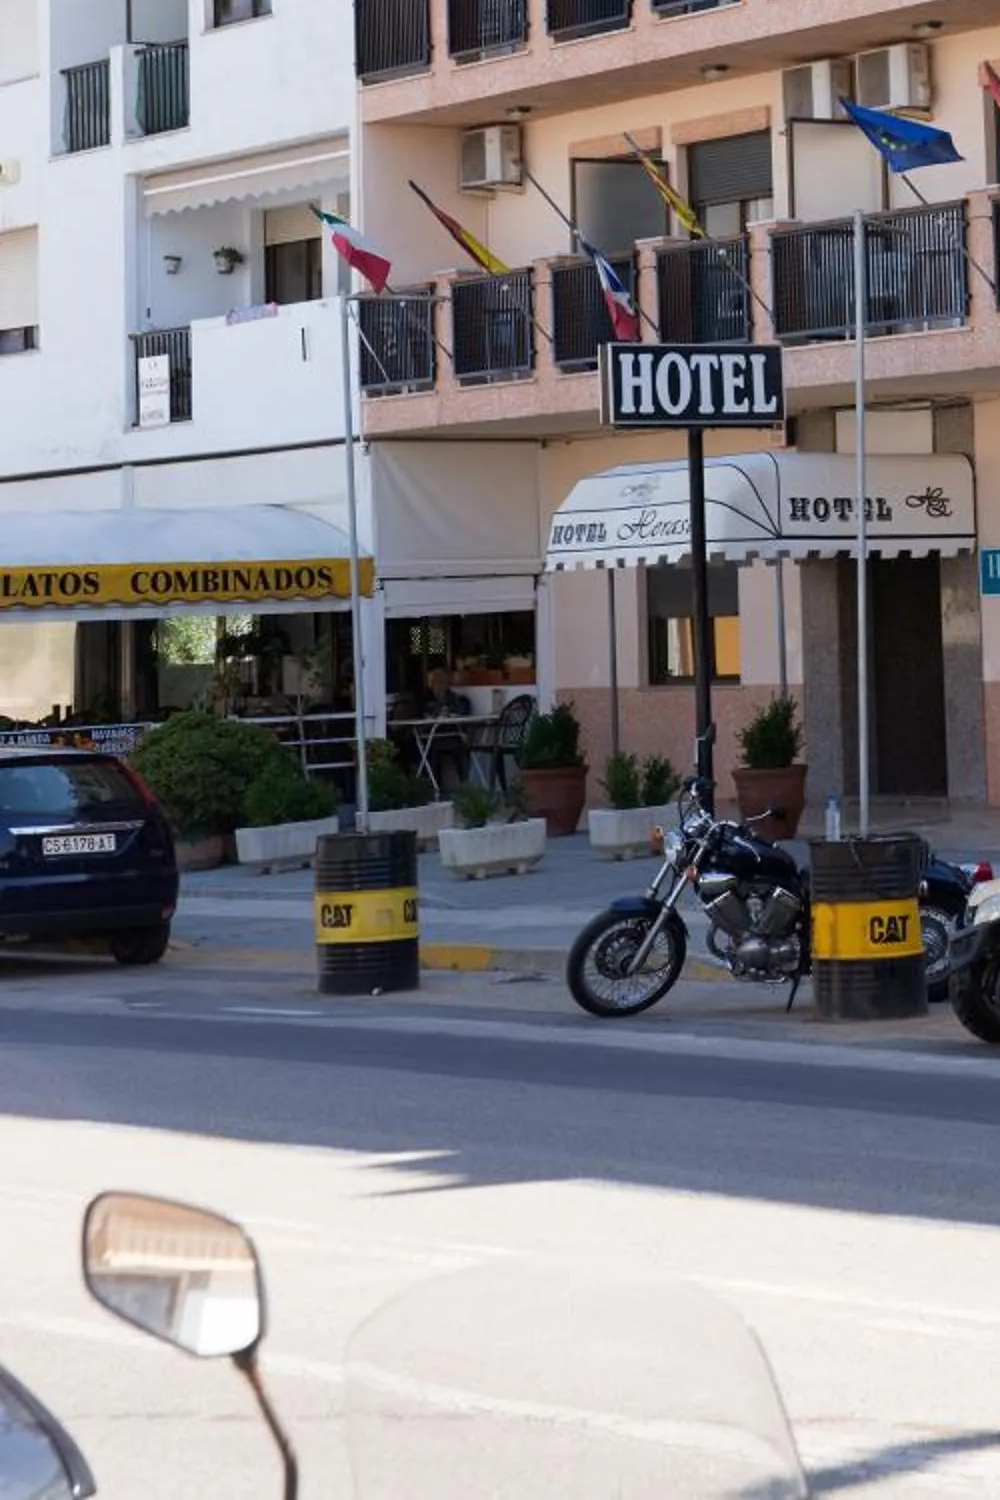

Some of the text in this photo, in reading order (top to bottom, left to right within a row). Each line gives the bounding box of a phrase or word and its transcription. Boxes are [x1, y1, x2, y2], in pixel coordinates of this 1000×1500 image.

[618, 352, 778, 415] HOTEL
[551, 522, 608, 545] HOTEL
[2, 565, 334, 597] LATOS COMBINADOS
[321, 903, 353, 928] CAT
[869, 914, 910, 945] CAT
